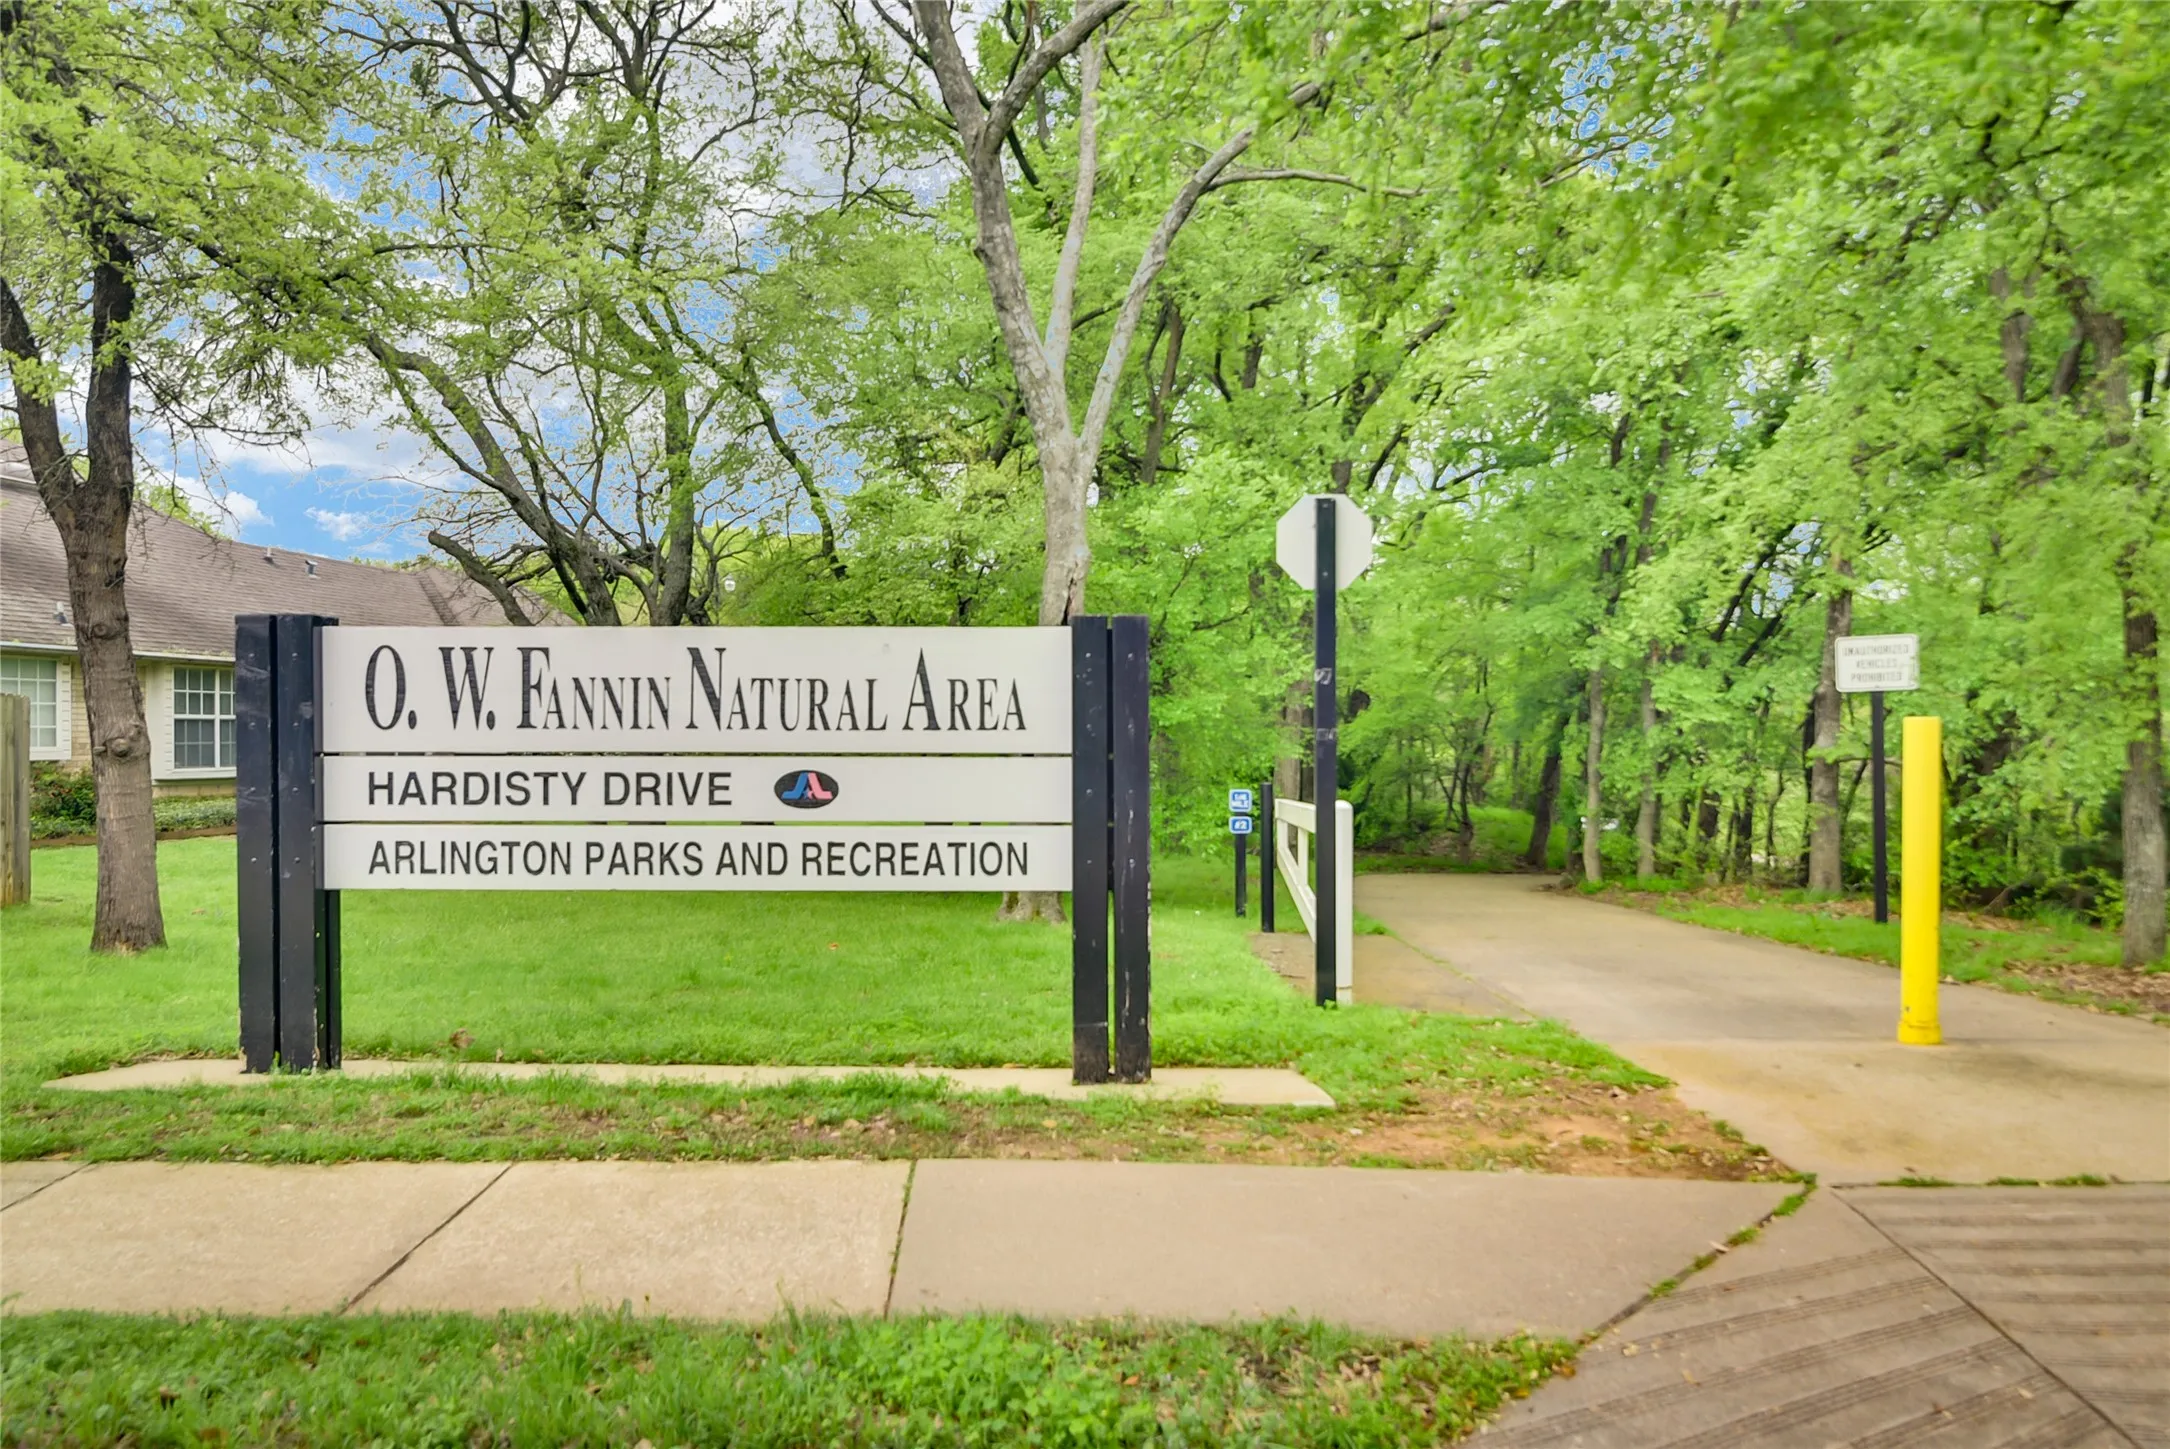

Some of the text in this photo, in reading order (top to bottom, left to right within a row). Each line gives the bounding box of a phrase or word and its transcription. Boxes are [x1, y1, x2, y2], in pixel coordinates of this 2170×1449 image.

[366, 645, 1028, 731] O. W. FANNIN NATURAL AREA
[368, 771, 732, 806] HARDISTY DRIVE
[368, 840, 1028, 876] ARLINGTON PARKS AND RECREATION
